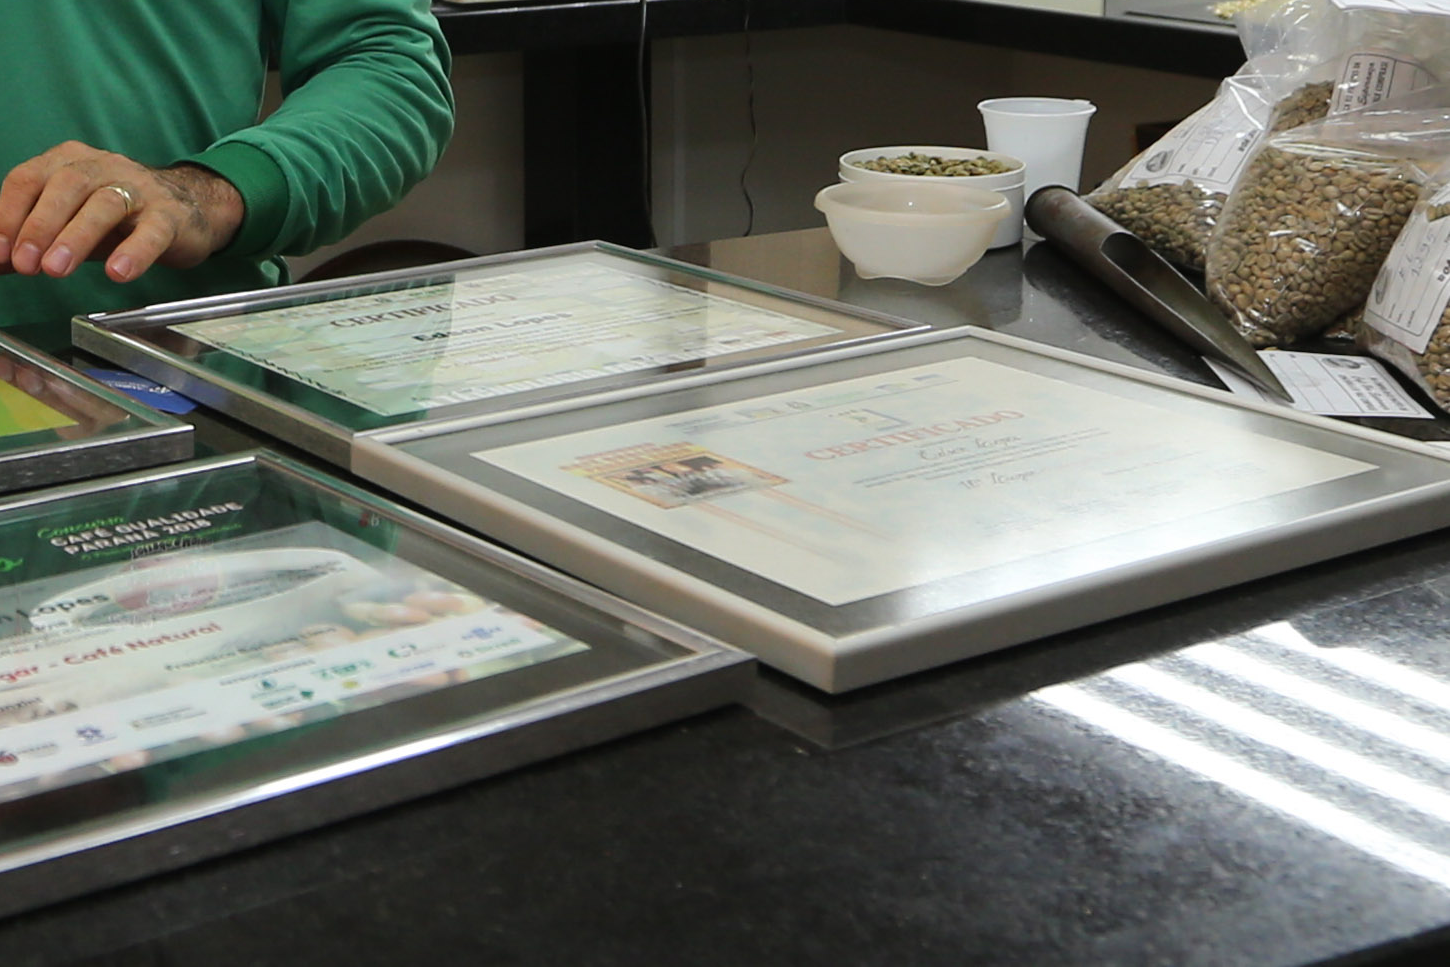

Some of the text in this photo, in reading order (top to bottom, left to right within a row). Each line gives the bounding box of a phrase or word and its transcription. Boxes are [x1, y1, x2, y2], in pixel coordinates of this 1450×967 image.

[331, 293, 517, 329] CERTIFICADO
[413, 323, 492, 342] Edson
[804, 410, 1025, 462] CERTIFICADO
[50, 527, 113, 547] CAFÉ
[114, 502, 243, 535] QUALIDADE
[63, 529, 160, 555] PARANÁ
[16, 593, 110, 618] Lopes
[64, 644, 125, 666] Café
[127, 622, 222, 651] Natural
